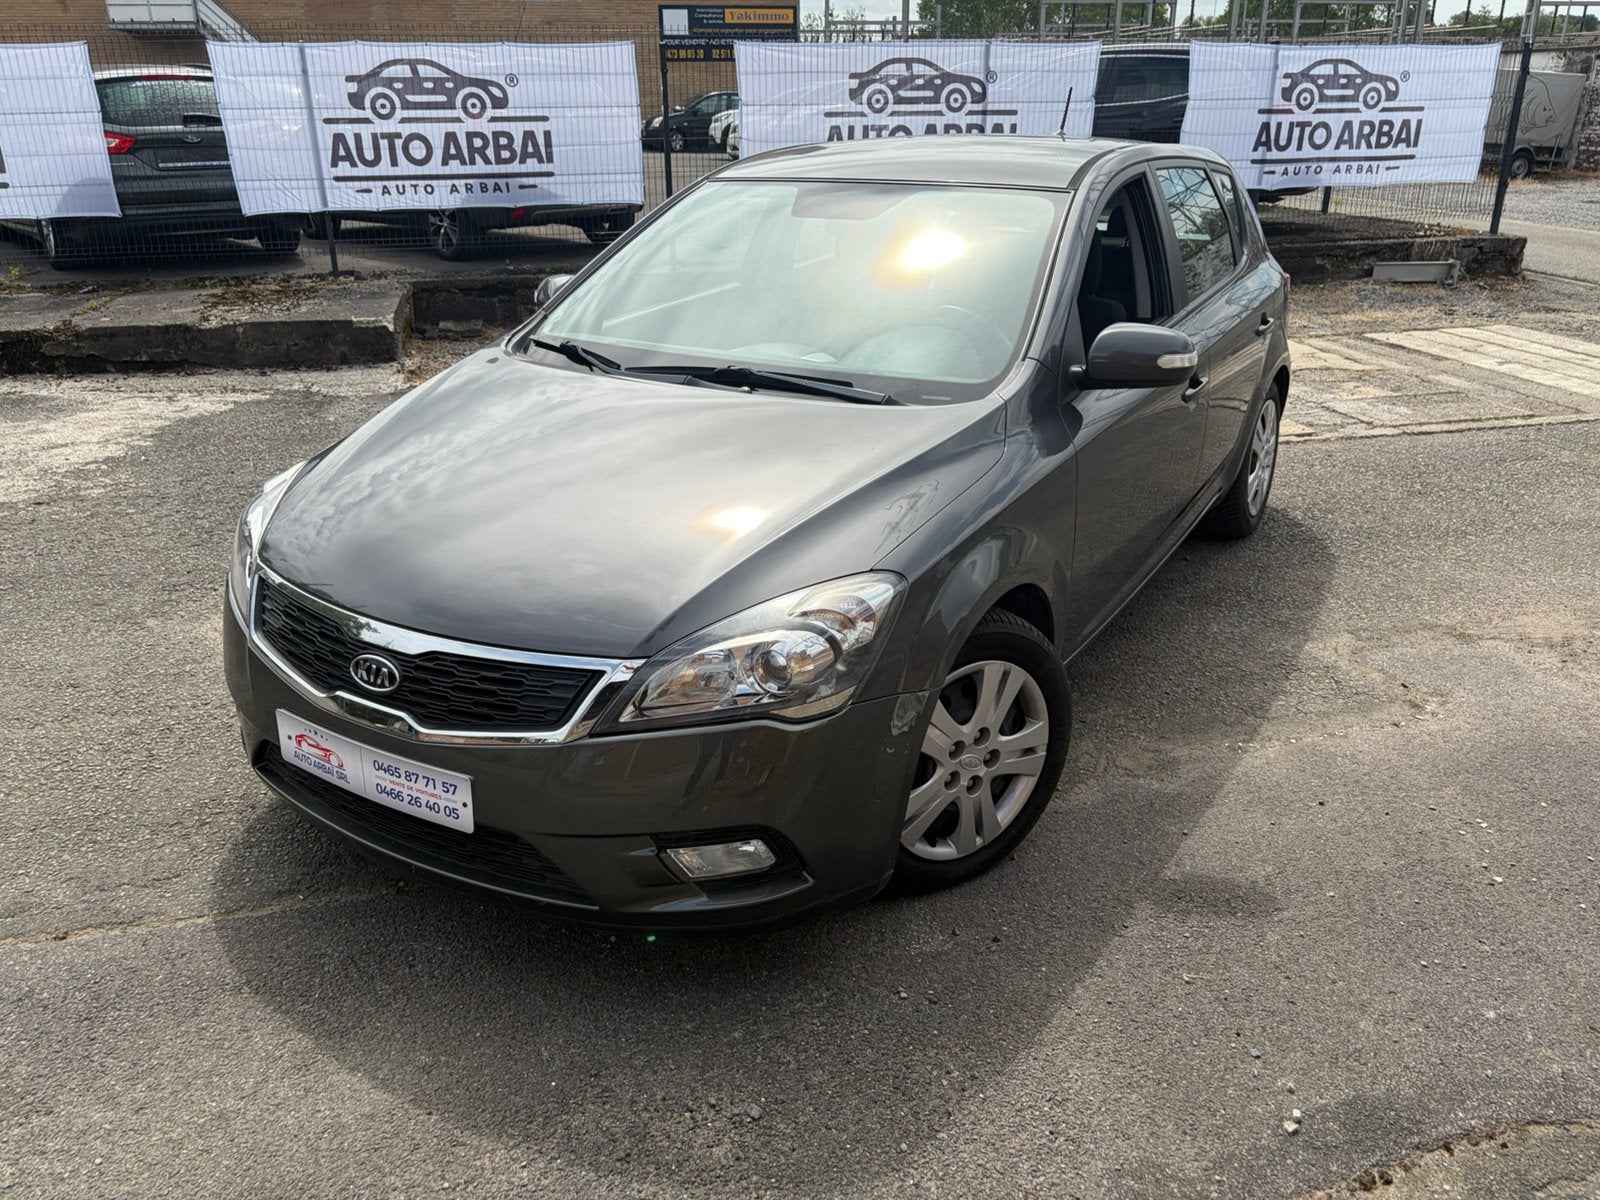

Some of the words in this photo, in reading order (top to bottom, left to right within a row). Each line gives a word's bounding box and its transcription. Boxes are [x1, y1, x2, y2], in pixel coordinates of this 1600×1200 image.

[729, 10, 789, 21] Yakimmo
[330, 131, 433, 168] AUTO
[441, 130, 554, 167] ARBAI
[1251, 120, 1332, 152] AUTO
[1333, 118, 1423, 150] ARBAI
[1281, 165, 1323, 177] AUTO
[1332, 163, 1380, 176] ARBAI
[381, 183, 435, 196] AUTO
[449, 181, 510, 196] ARBAI
[357, 660, 390, 688] KIA
[294, 750, 312, 766] AUTO
[335, 770, 351, 784] SRL
[373, 759, 401, 779] 0465
[404, 770, 419, 784] 87
[422, 775, 437, 790] 71
[441, 781, 458, 796] 57
[375, 783, 404, 802] 0466
[406, 794, 422, 808] 26
[425, 800, 440, 814] 40
[443, 805, 460, 820] 05
[388, 779, 405, 789] VENTE
[415, 787, 442, 800] VOITURES
